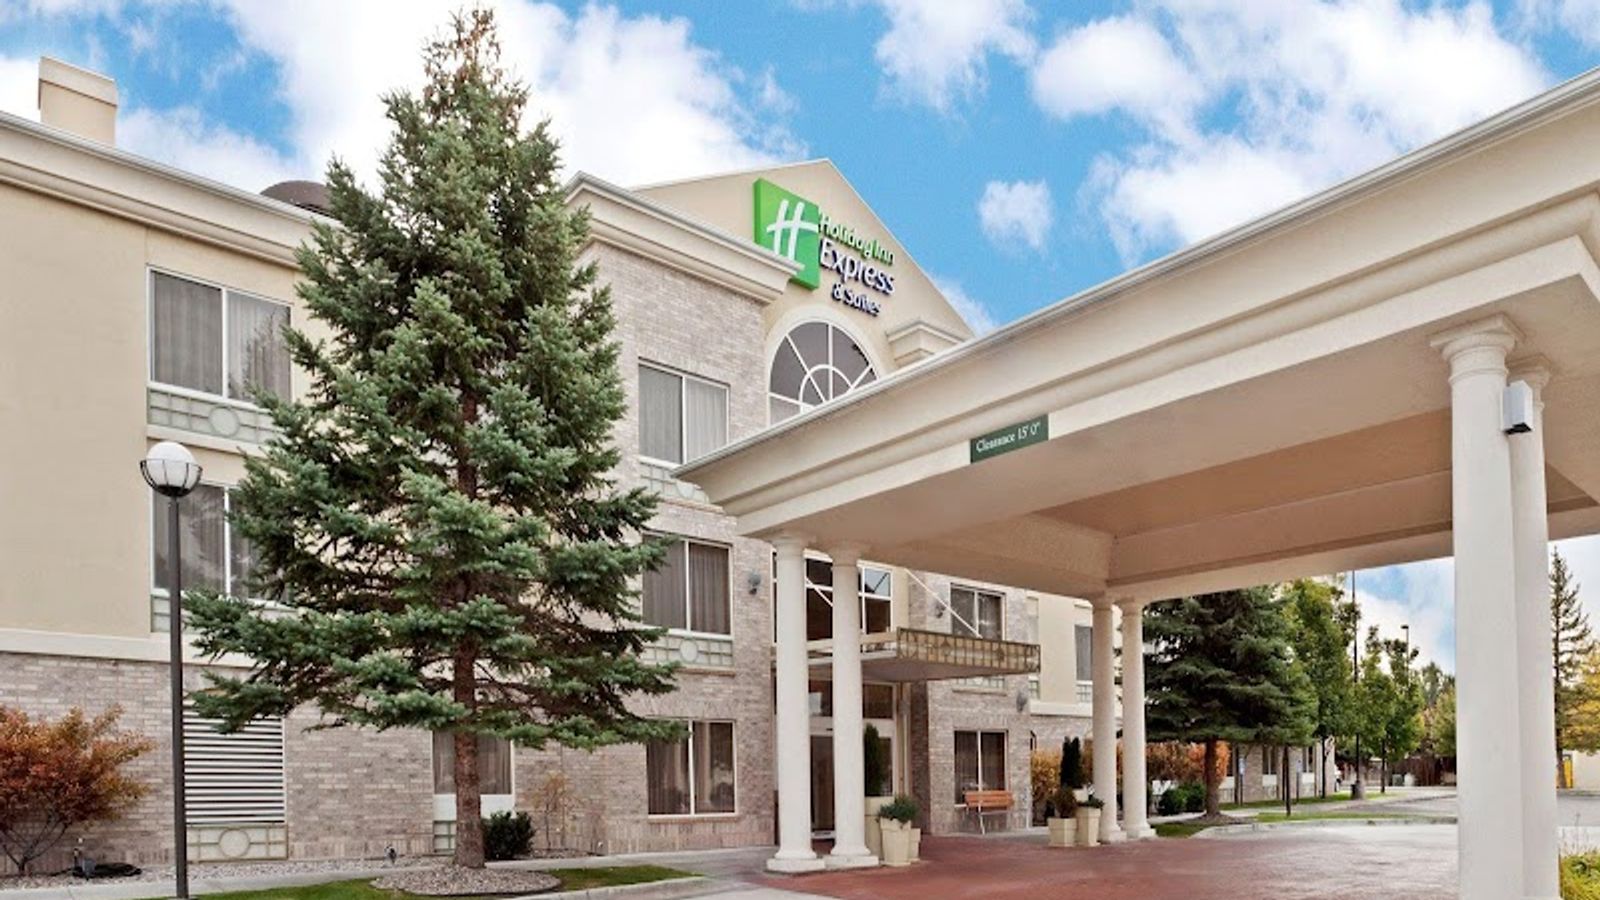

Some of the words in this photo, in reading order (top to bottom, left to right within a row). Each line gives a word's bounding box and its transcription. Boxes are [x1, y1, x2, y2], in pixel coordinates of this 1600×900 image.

[819, 213, 873, 259] Holiday
[872, 240, 895, 266] Inn
[820, 237, 895, 295] Express
[832, 283, 844, 301] &
[844, 289, 881, 316] Suites
